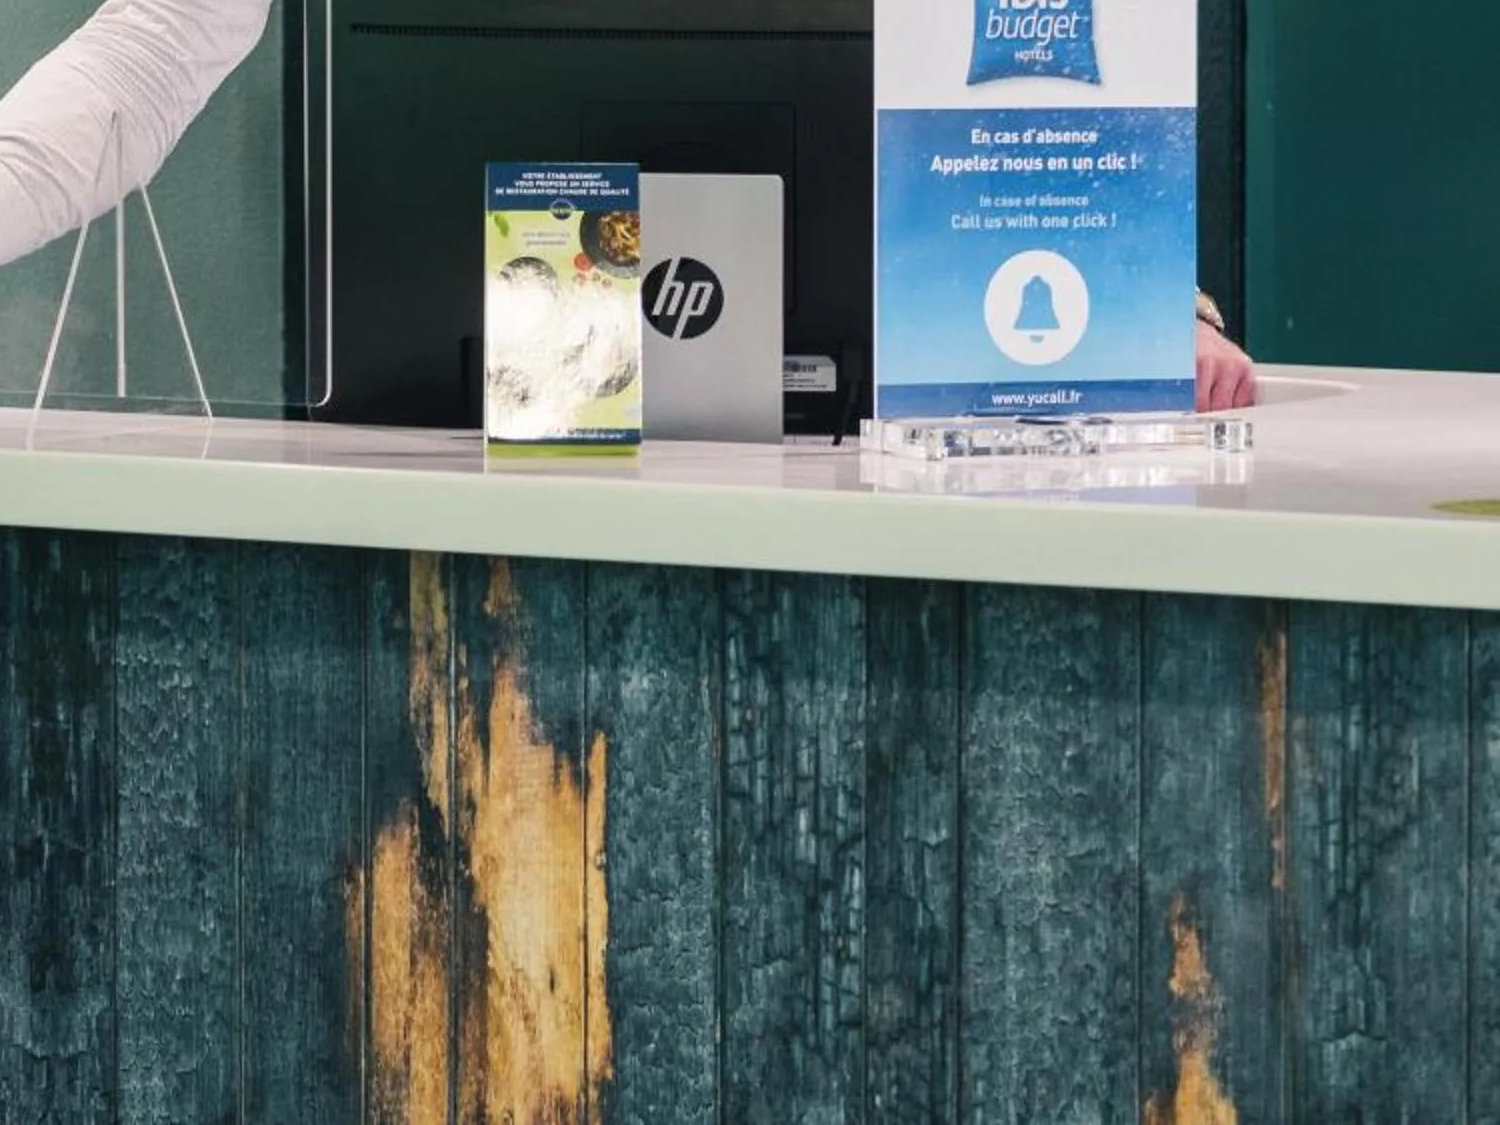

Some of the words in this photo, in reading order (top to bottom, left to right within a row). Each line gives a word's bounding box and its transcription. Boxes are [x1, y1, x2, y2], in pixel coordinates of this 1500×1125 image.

[985, 8, 1080, 46] budget
[971, 128, 990, 144] En
[994, 131, 1019, 144] cas
[1022, 128, 1099, 144] d'absence
[931, 154, 999, 175] Appelez
[1003, 157, 1043, 171] nous
[1047, 157, 1068, 171] en
[1072, 157, 1093, 170] un
[1097, 151, 1126, 170] clic
[979, 194, 992, 207] In
[994, 197, 1021, 207] case
[1025, 195, 1037, 207] of
[1039, 194, 1089, 207] absence
[951, 213, 980, 230] Call
[984, 217, 1000, 229] us
[1003, 213, 1039, 229] with
[1042, 216, 1069, 228] one
[1072, 211, 1107, 228] click
[652, 256, 715, 340] hp
[991, 390, 1083, 407] www.yucall.fr
